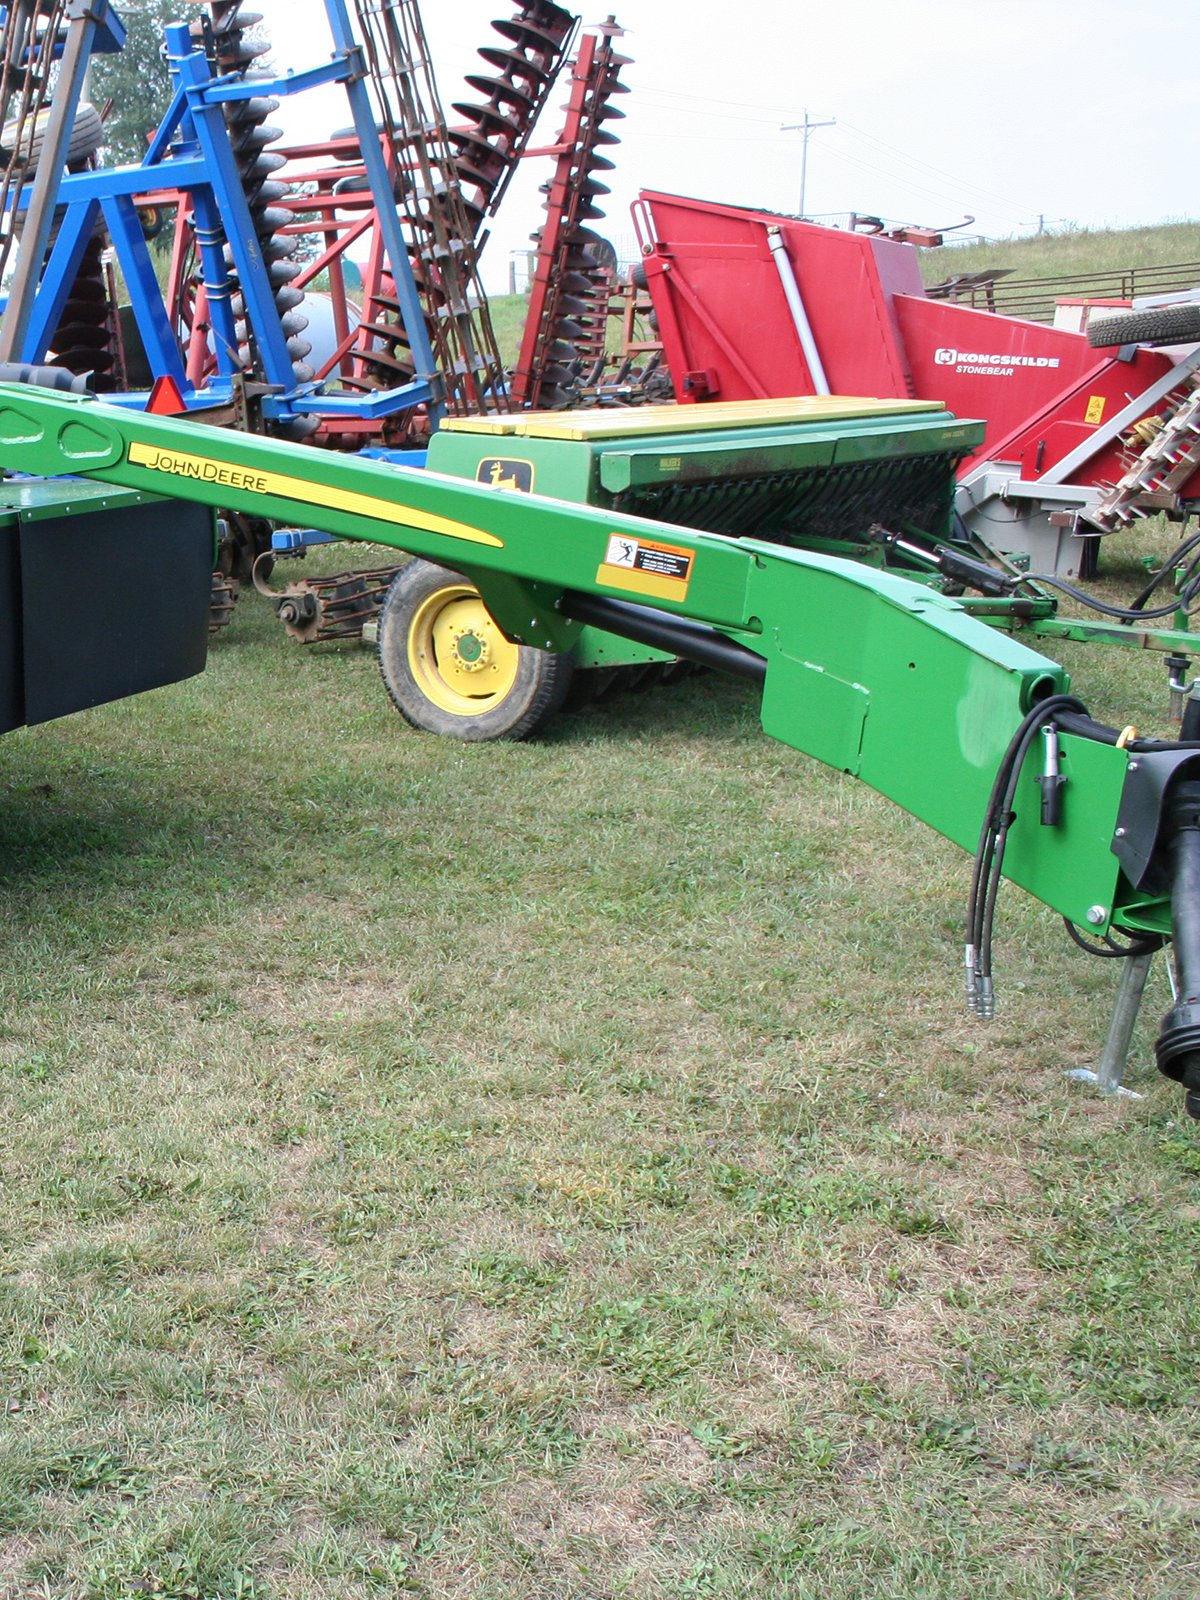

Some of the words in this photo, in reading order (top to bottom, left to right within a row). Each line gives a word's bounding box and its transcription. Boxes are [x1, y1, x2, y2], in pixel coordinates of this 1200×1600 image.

[957, 353, 1060, 368] KONGSKILDE
[956, 365, 1014, 376] STONEBEAR
[149, 453, 200, 476] JOHN
[203, 463, 267, 491] DEERE
